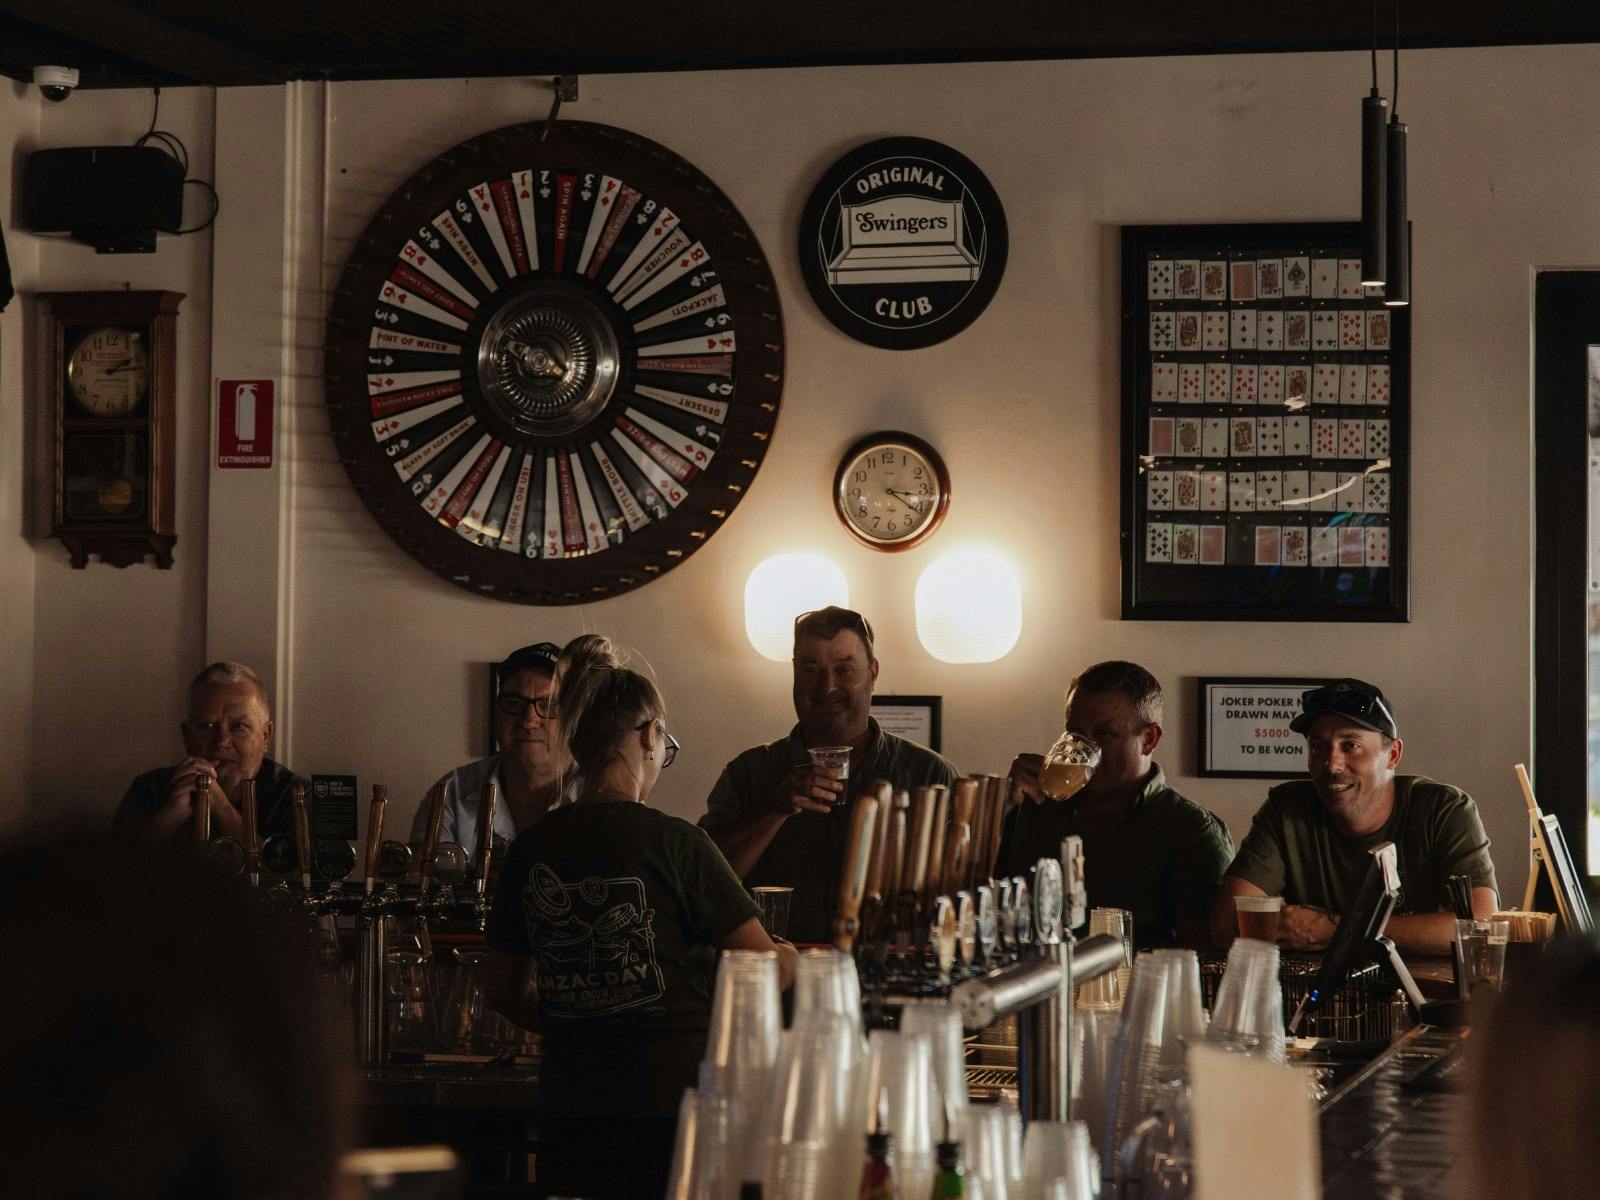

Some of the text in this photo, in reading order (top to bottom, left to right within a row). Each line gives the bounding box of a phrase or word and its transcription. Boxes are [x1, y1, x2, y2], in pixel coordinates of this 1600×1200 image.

[520, 172, 526, 186] J
[540, 170, 549, 184] 2
[584, 173, 594, 187] 3
[856, 166, 944, 194] ORIGINAL
[605, 180, 615, 192] 4
[474, 186, 484, 200] A
[455, 199, 466, 212] 9
[558, 181, 570, 239] SPIN AGAIN
[643, 199, 656, 213] 8
[661, 213, 674, 227] 2
[855, 212, 948, 234] Swingers
[418, 226, 431, 240] 5
[441, 217, 478, 265] SPIN AGAIN
[404, 245, 416, 258] 8
[644, 234, 683, 274] VOUCHER
[690, 247, 704, 261] 8
[700, 271, 715, 281] 7
[383, 286, 395, 297] 6
[875, 296, 933, 319] CLUB
[374, 309, 387, 320] 3
[717, 313, 730, 324] 9
[94, 337, 102, 350] 11
[106, 332, 118, 346] 12
[377, 333, 446, 350] PINT OF WATER
[720, 337, 732, 347] 4
[367, 378, 382, 388] 7
[718, 383, 733, 394] Q
[92, 394, 99, 406] 7
[106, 397, 115, 409] 6
[678, 398, 720, 416] DESSERT
[375, 423, 388, 434] 3
[449, 421, 469, 437] DRINK
[707, 431, 720, 442] J
[237, 444, 254, 453] FIRE
[385, 444, 399, 456] 5
[220, 455, 271, 464] EXTINGUISHER
[695, 450, 707, 461] 9
[881, 451, 894, 464] 12
[902, 455, 906, 466] 1
[867, 458, 876, 469] 11
[601, 458, 619, 485] BOMB
[855, 470, 867, 482] 10
[913, 468, 923, 480] 2
[412, 481, 423, 495] Q
[515, 486, 524, 501] ON
[520, 467, 529, 483] US!
[918, 483, 929, 496] 3
[669, 491, 680, 501] 6
[852, 488, 861, 500] 9
[652, 502, 666, 518] 2
[858, 505, 868, 518] 8
[914, 501, 924, 513] 4
[872, 516, 881, 528] 7
[887, 519, 896, 531] 6
[903, 514, 913, 526] 5
[525, 543, 536, 558] 6
[549, 543, 557, 555] 3
[1220, 697, 1254, 706] JOKER
[1258, 697, 1293, 707] POKER
[1226, 710, 1297, 720] DRAWN MAY
[1254, 728, 1290, 738] $5000
[1241, 745, 1303, 755] TO BE WON
[605, 963, 648, 985] DAY
